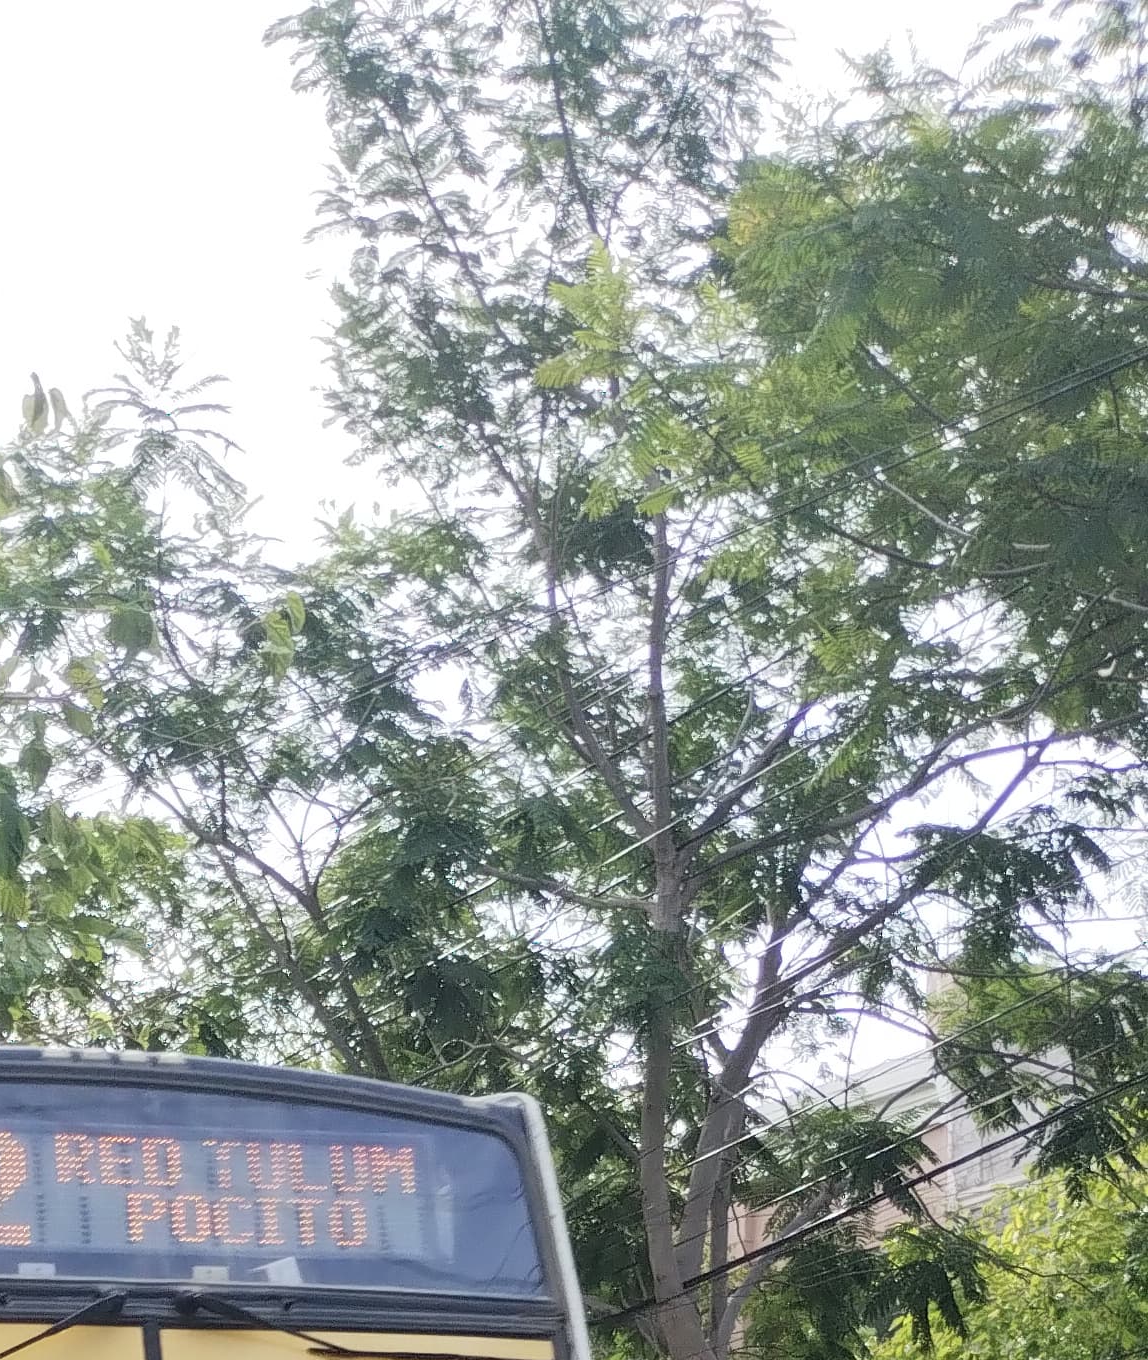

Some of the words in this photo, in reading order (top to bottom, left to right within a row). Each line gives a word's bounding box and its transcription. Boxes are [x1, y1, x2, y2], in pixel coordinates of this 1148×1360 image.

[54, 1132, 185, 1187] RED
[202, 1139, 417, 1195] TULUM
[126, 1192, 368, 1248] POCITO
